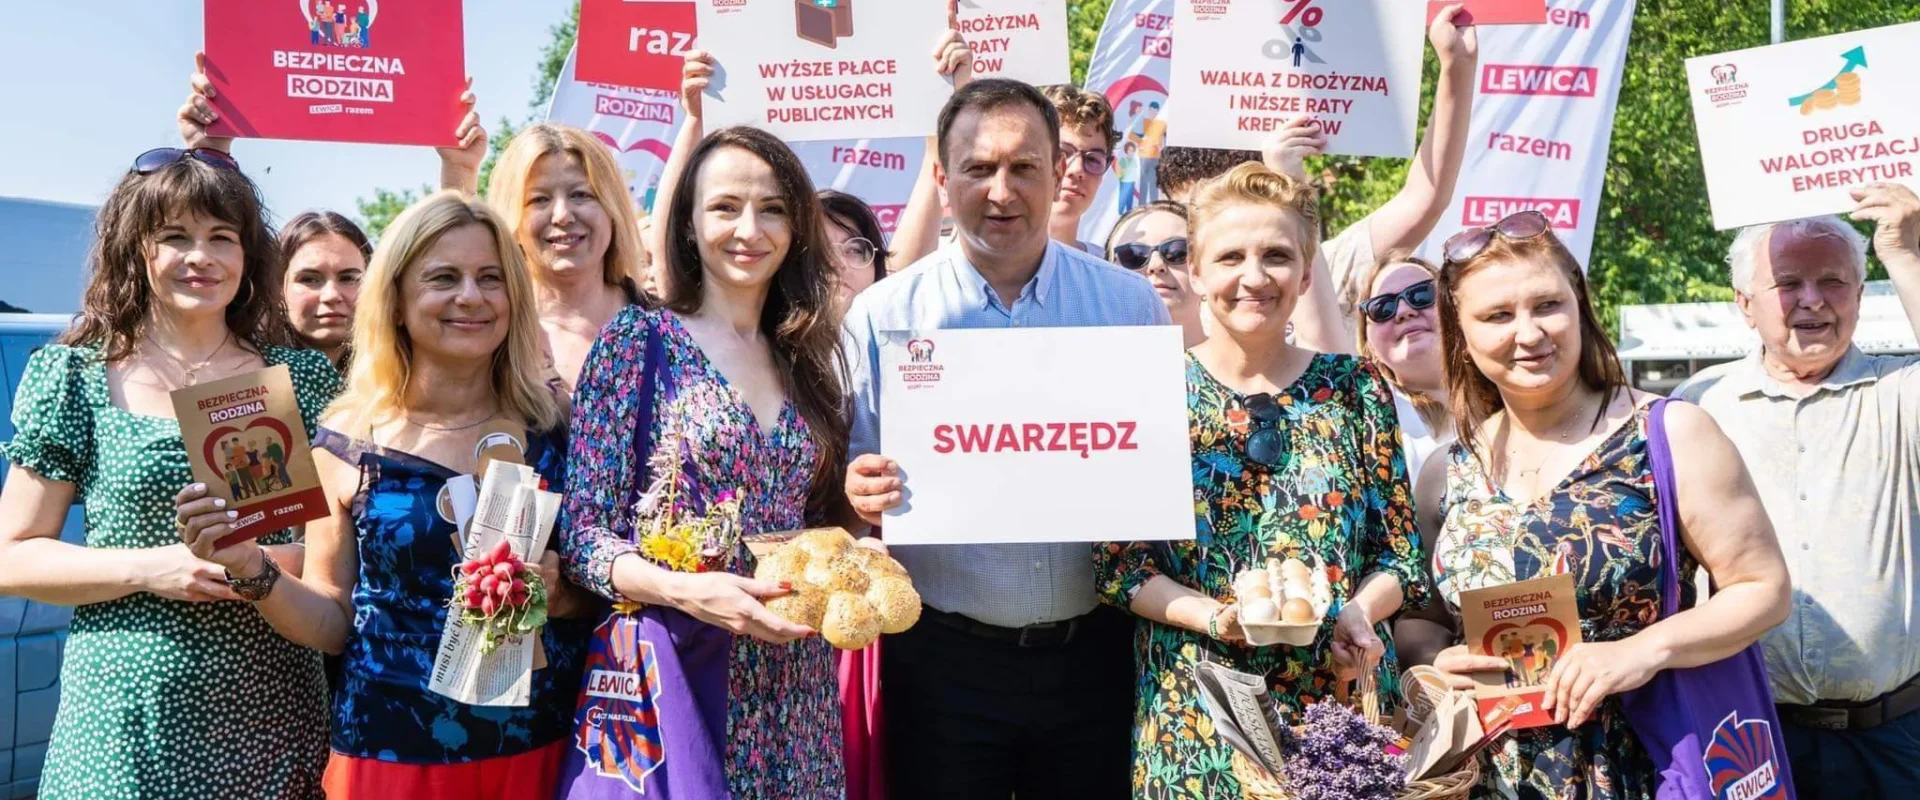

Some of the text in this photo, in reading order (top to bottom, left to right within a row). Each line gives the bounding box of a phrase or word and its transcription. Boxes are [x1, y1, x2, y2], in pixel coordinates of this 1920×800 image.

[628, 26, 697, 58] raz
[968, 38, 1010, 53] RATY
[273, 50, 405, 75] BEZPIECZNA
[758, 59, 897, 78] WYŻSZE PŁACE
[292, 78, 390, 99] RODZINA
[766, 83, 892, 101] W USŁUGACH
[1200, 70, 1389, 96] WALKA Z DROŻYZNĄ
[1487, 68, 1590, 93] LEWICA
[345, 106, 374, 114] razem
[598, 99, 672, 123] RODZINA
[767, 104, 894, 123] PUBLICZNYCH
[1229, 92, 1353, 114] I NIŻSZE RATY
[1802, 120, 1883, 145] DRUGA
[1488, 131, 1571, 161] razem
[832, 146, 905, 171] razem
[1792, 161, 1913, 192] EMERYTUR
[898, 364, 944, 372] BEZPIECZNA
[197, 385, 269, 410] BEZPIECZNA
[210, 401, 265, 423] RODZINA
[933, 421, 1138, 459] SWARZĘDZ
[234, 503, 304, 528] EWICA razem
[1483, 590, 1552, 609] BEZPIECZNA
[1493, 604, 1546, 620] RODZINA
[435, 651, 451, 684] musi
[444, 626, 460, 652] być
